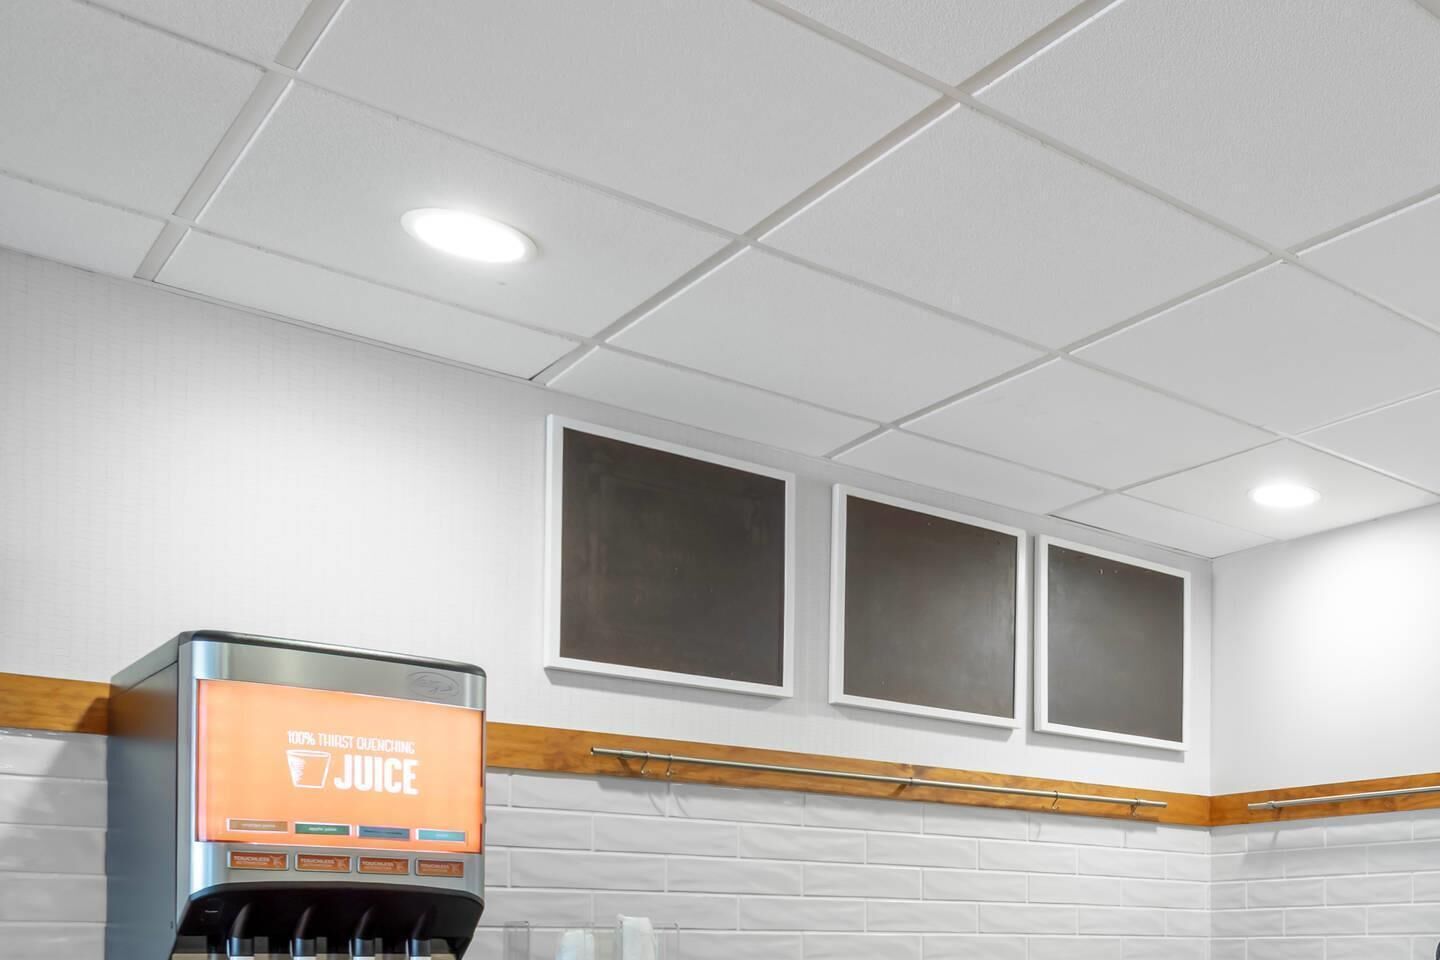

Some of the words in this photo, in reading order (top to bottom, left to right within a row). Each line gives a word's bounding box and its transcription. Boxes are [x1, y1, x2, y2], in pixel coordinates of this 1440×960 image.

[287, 729, 316, 746] 100%
[318, 732, 354, 749] THIRST
[356, 736, 416, 754] QUENCHING
[333, 754, 419, 796] JUICE
